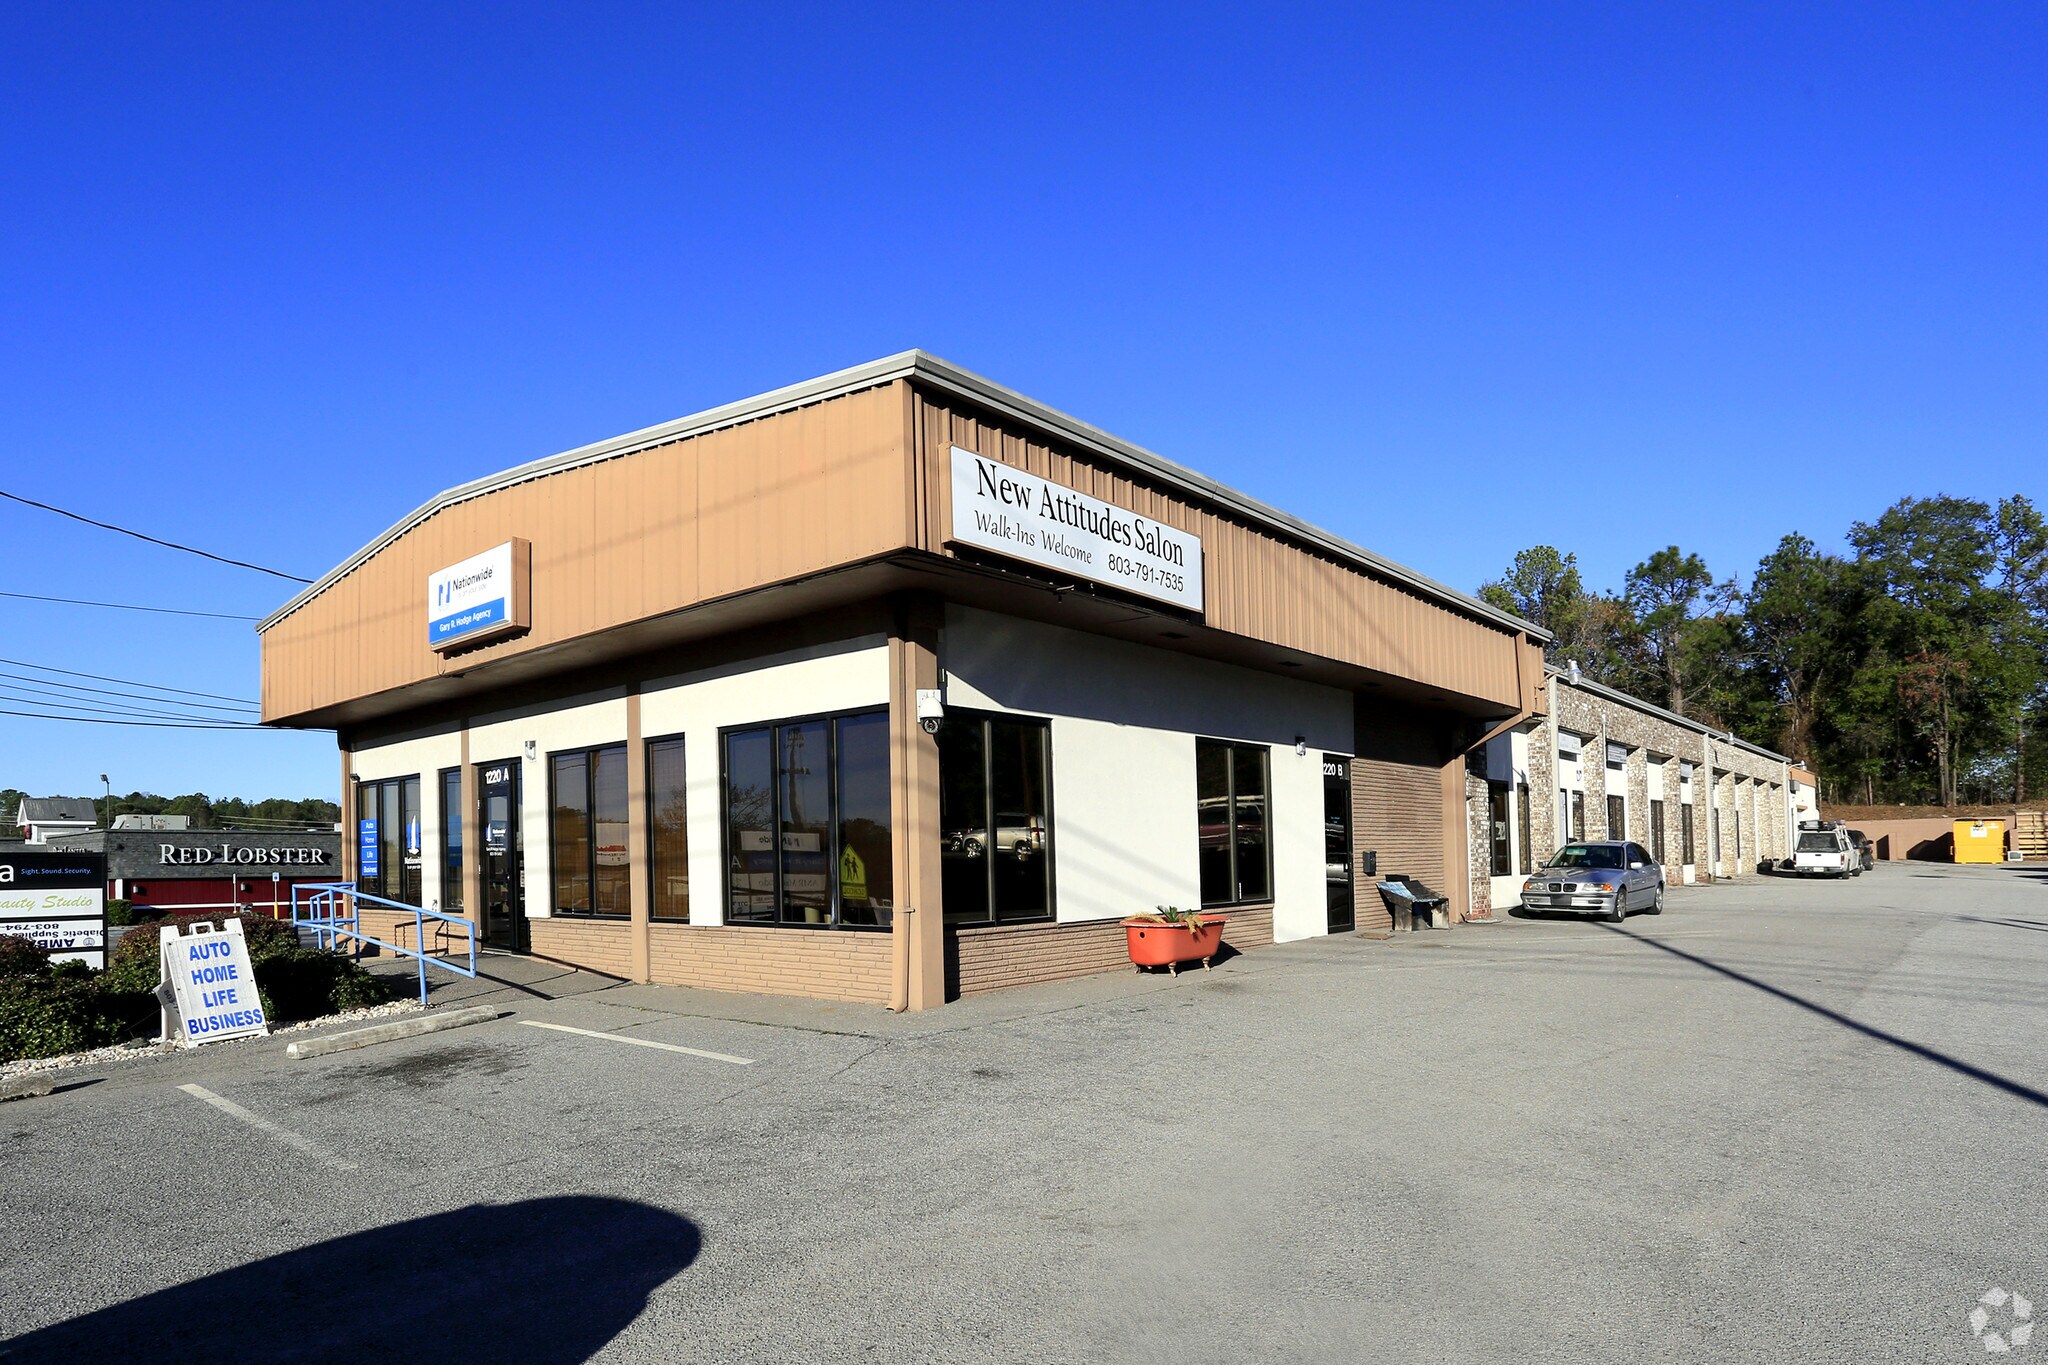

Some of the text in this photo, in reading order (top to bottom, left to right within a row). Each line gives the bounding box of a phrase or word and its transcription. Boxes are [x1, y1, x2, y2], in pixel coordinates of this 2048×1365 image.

[975, 458, 1184, 568] New Attitudes Salon
[974, 510, 1092, 565] Walk-Ins Welcome
[452, 566, 493, 591] Nationwide
[1108, 553, 1184, 592] 803-791-7535
[439, 623, 451, 632] Gary
[455, 616, 472, 626] Hodge
[472, 609, 492, 622] Agency
[485, 767, 510, 784] 1220 A
[1323, 763, 1343, 776] 220 B
[159, 844, 325, 864] RED LOBSTER
[0, 895, 93, 912] auty Studio
[62, 929, 104, 938] Diabetic
[189, 941, 231, 962] AUTO
[190, 964, 239, 986] HOME
[202, 988, 239, 1008] LIFE
[187, 1008, 263, 1035] BUSINESS
